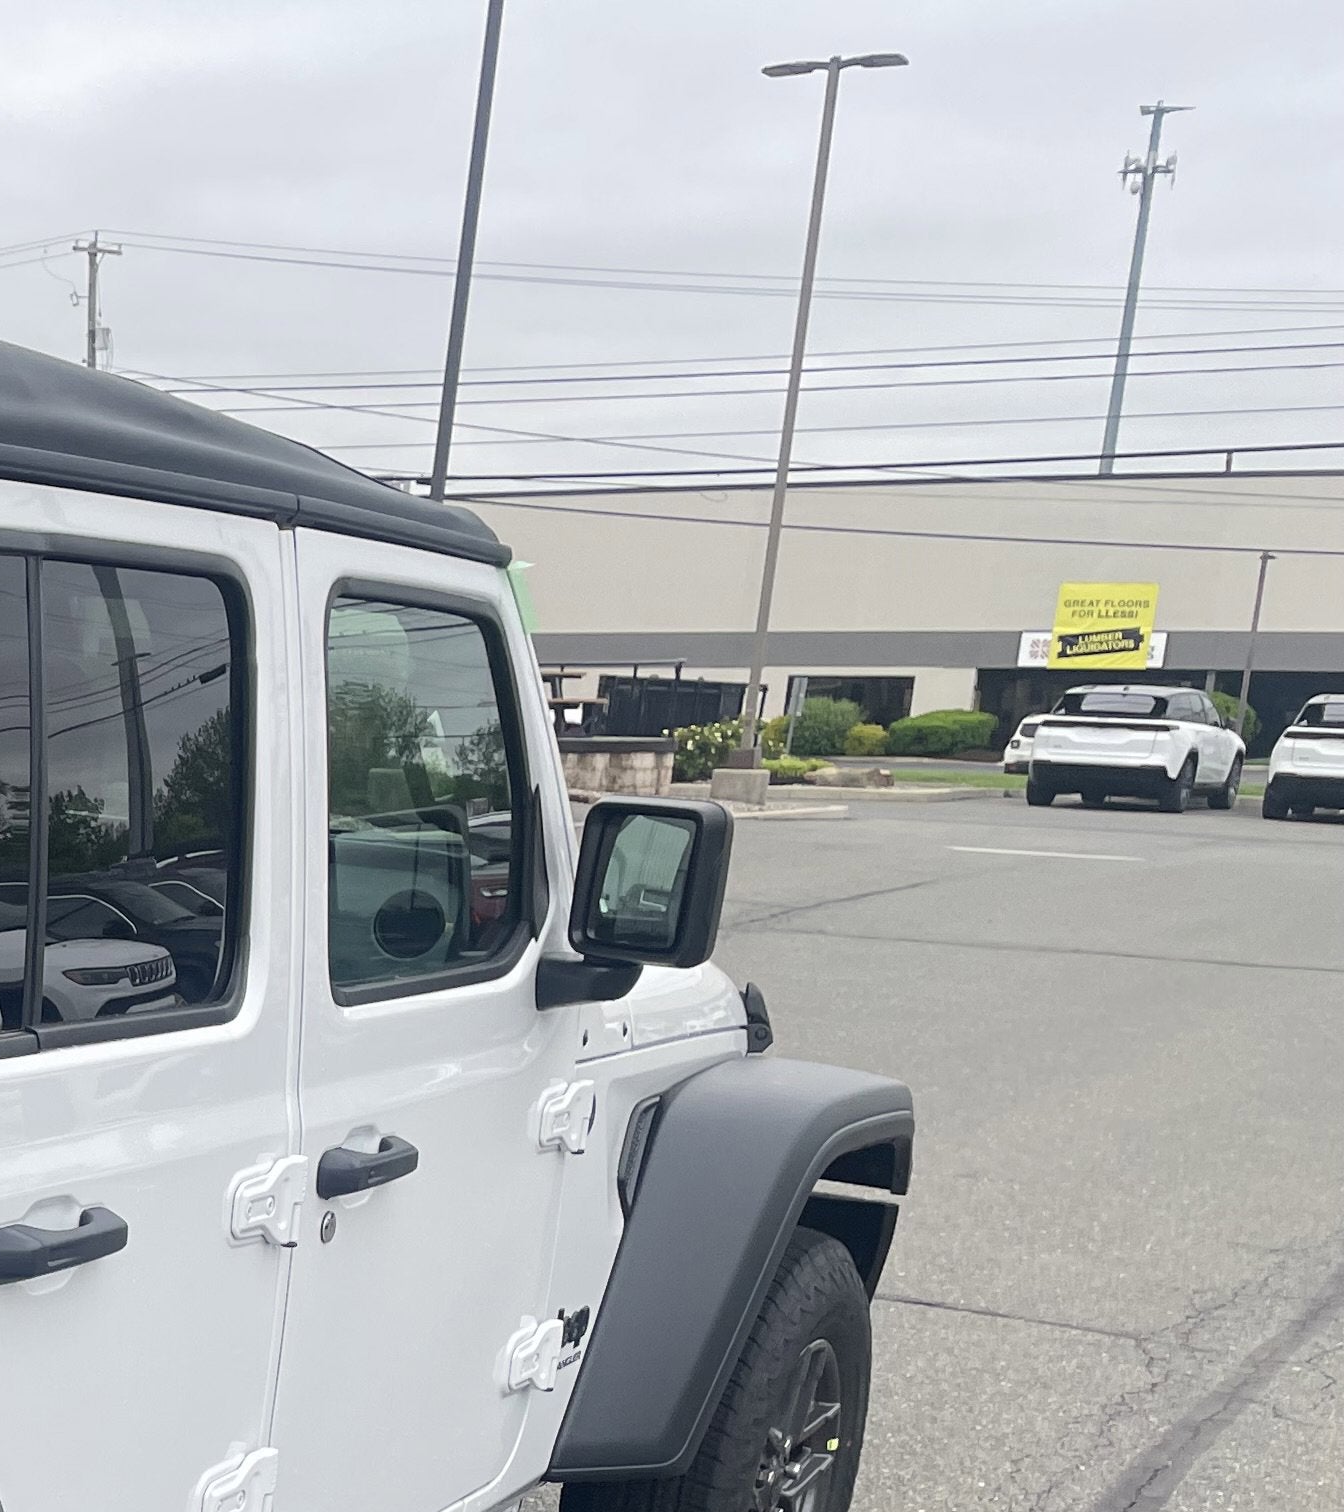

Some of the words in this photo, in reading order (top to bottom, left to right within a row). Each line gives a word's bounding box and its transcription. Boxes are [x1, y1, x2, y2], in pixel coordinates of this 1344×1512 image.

[1064, 599, 1101, 609] GREAT
[1103, 599, 1151, 609] FLOORS
[1071, 609, 1095, 619] FOR
[1077, 631, 1123, 643] LUMBER
[1066, 638, 1135, 655] LIQUIDATORS
